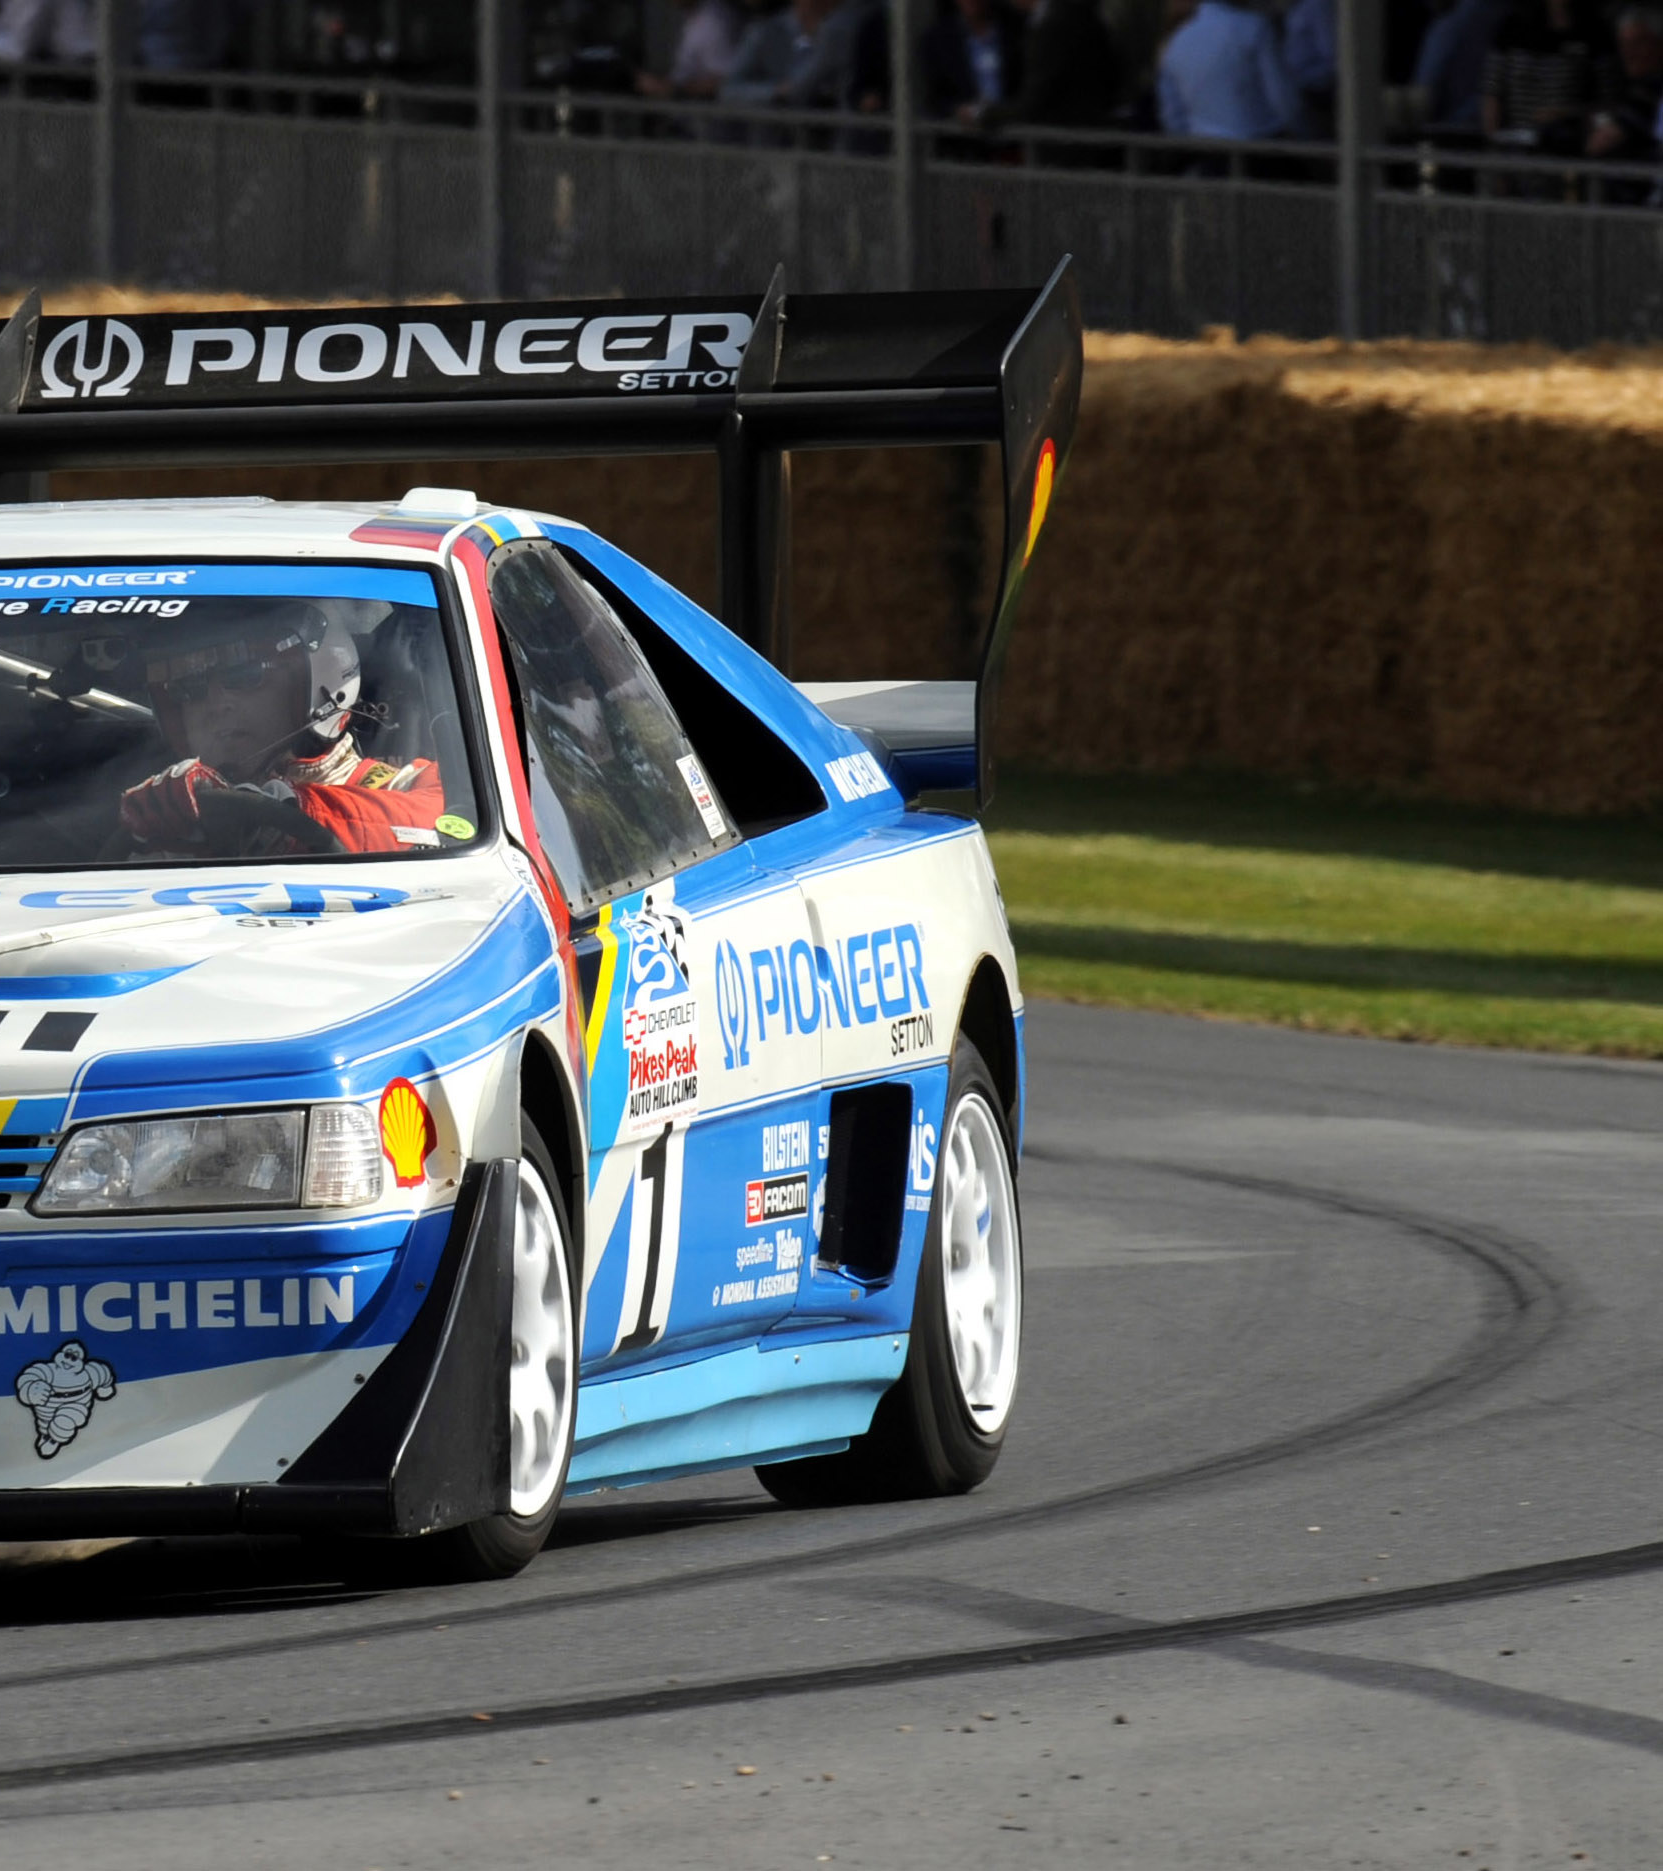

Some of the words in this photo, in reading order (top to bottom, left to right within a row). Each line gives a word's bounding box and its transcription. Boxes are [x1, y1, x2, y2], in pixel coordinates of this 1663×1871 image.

[165, 312, 754, 385] PIONEER
[40, 597, 189, 617] Racing
[750, 923, 930, 1041] PIONEER
[648, 1001, 696, 1033] CHEVROLET
[891, 1012, 934, 1057] SETTON
[630, 1047, 665, 1091] Pikes
[666, 1034, 698, 1079] Peak
[629, 1089, 652, 1119] AUTO
[653, 1083, 671, 1112] HILL
[672, 1075, 698, 1106] CLIMB
[763, 1120, 810, 1173] BILSTEIN
[763, 1182, 807, 1215] FACOM
[618, 1121, 675, 1351] 1
